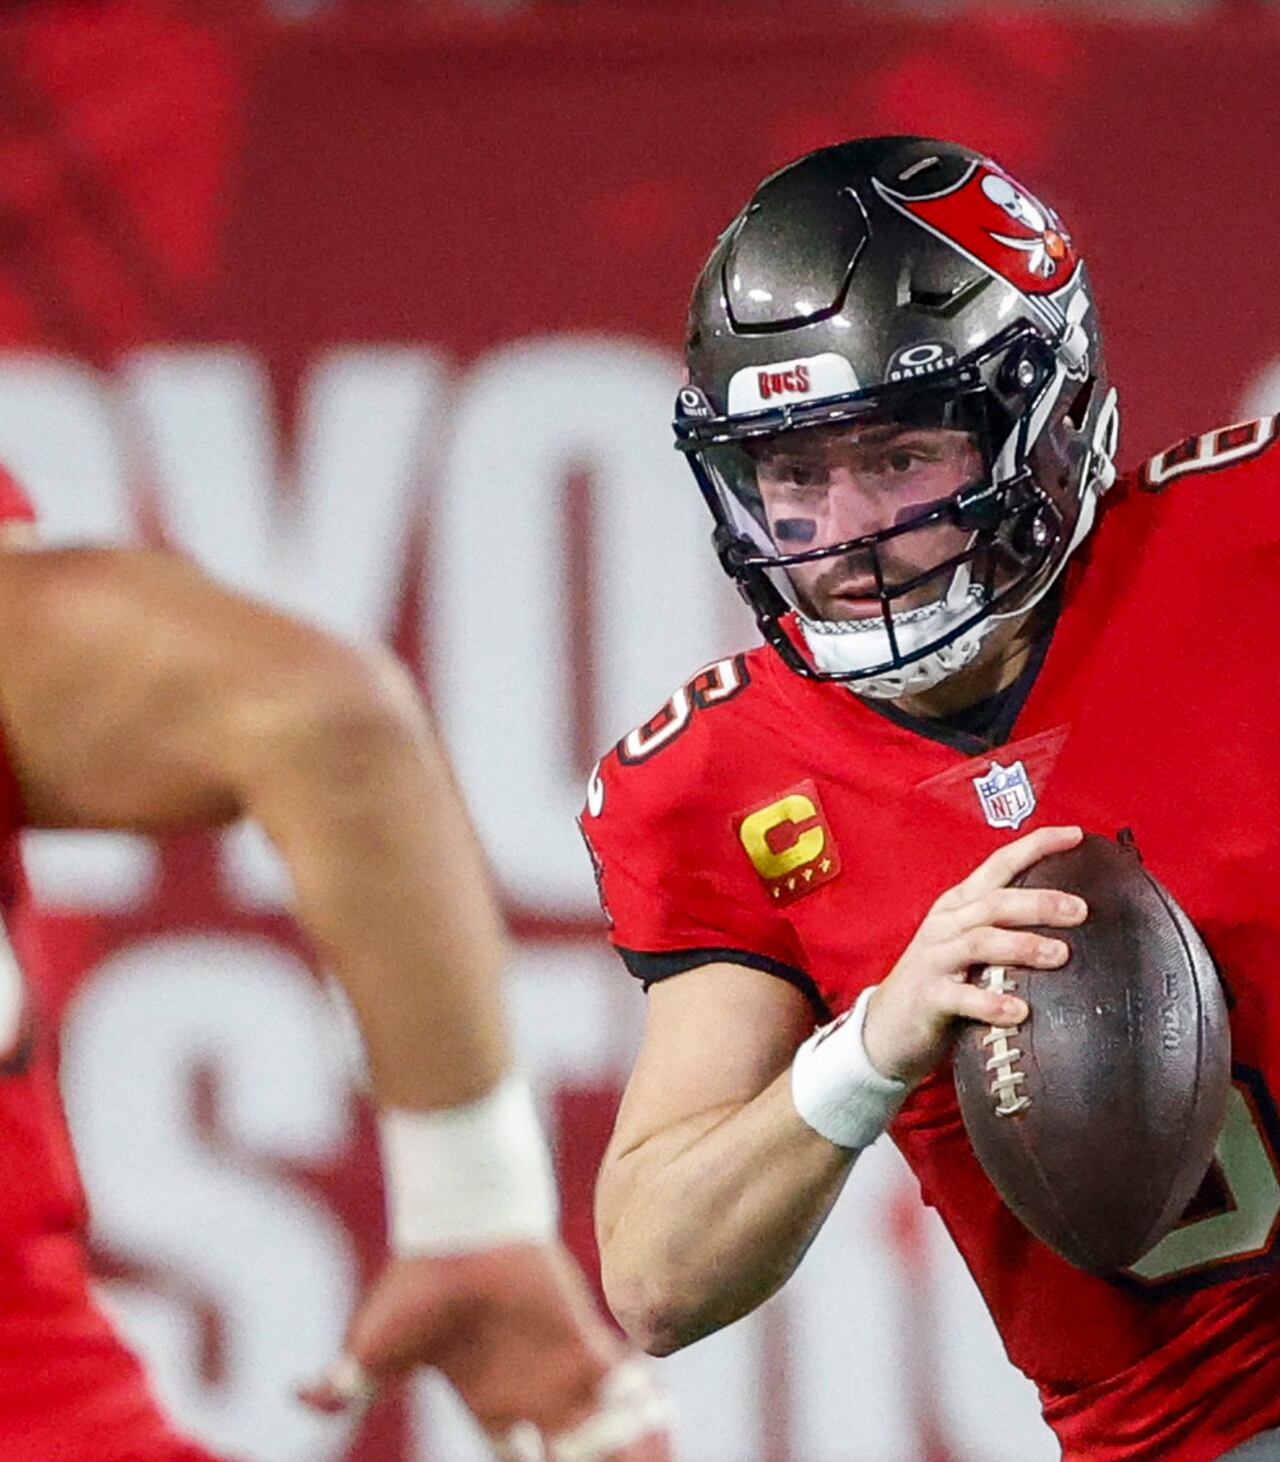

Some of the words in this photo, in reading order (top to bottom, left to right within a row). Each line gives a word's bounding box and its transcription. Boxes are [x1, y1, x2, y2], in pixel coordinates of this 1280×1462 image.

[617, 653, 750, 766] 6
[740, 794, 825, 879] C
[990, 789, 1027, 819] NFL
